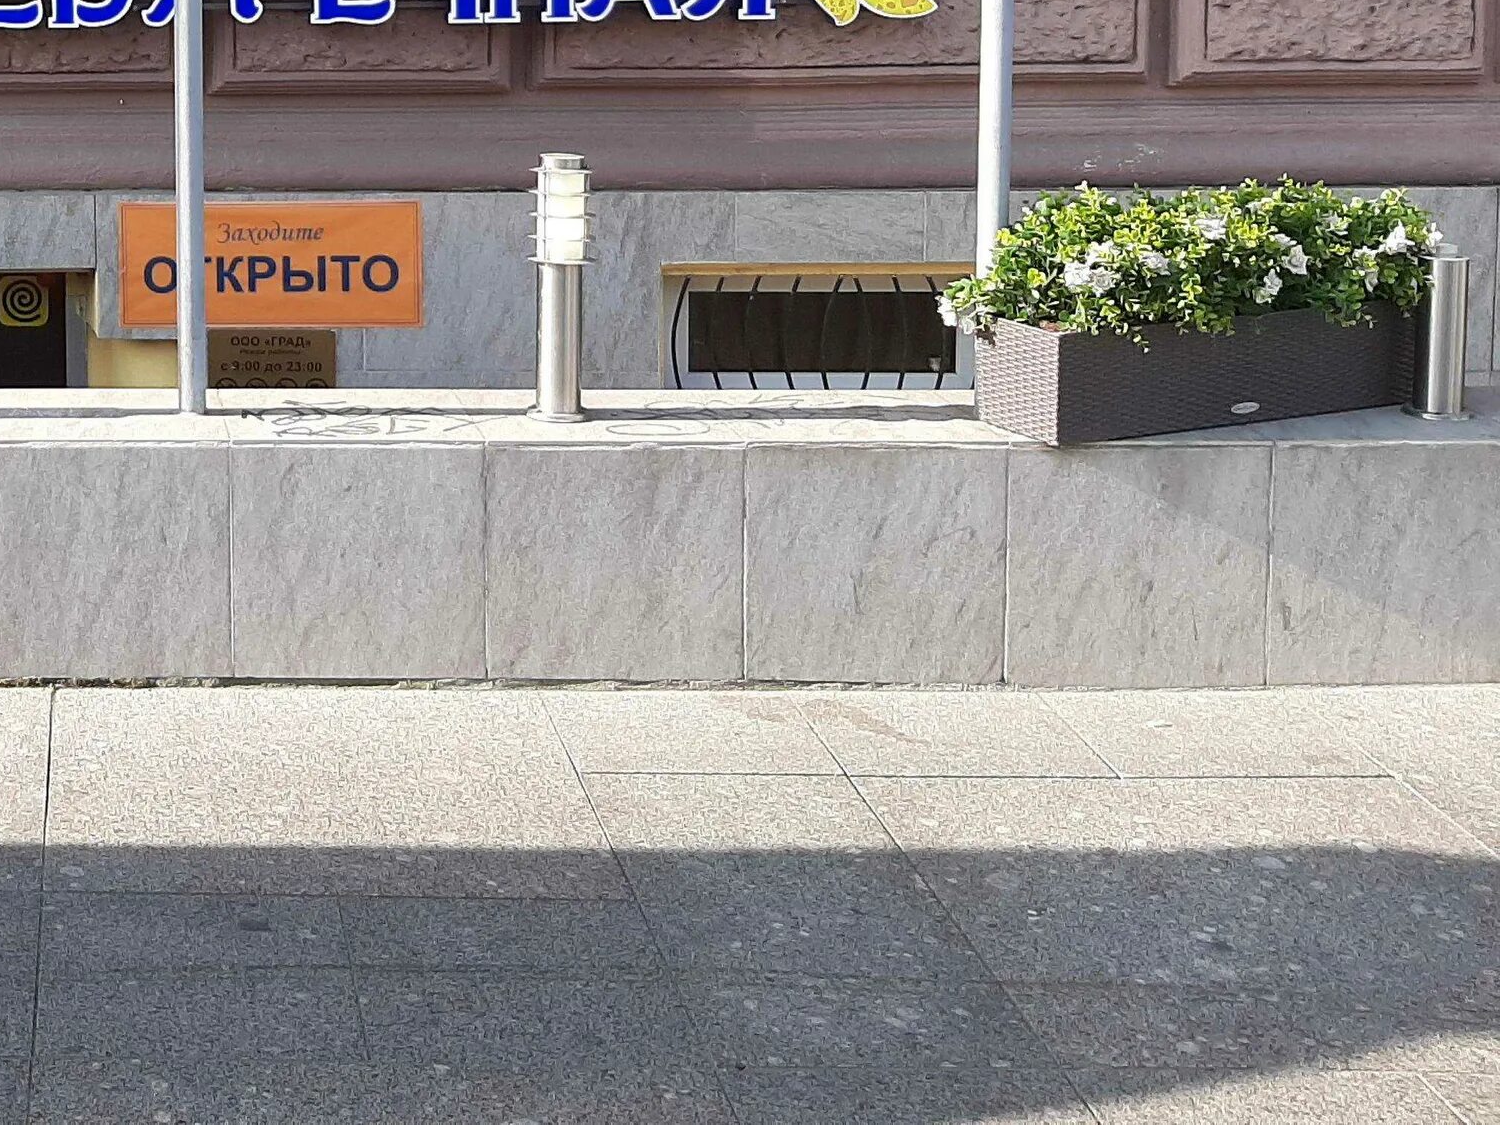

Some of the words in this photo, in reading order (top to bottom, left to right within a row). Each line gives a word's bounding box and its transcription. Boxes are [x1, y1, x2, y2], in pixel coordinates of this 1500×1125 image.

[217, 220, 324, 245] Заходите
[143, 254, 399, 294] ОКРЫТО
[230, 336, 260, 347] ООО
[264, 363, 282, 373] до
